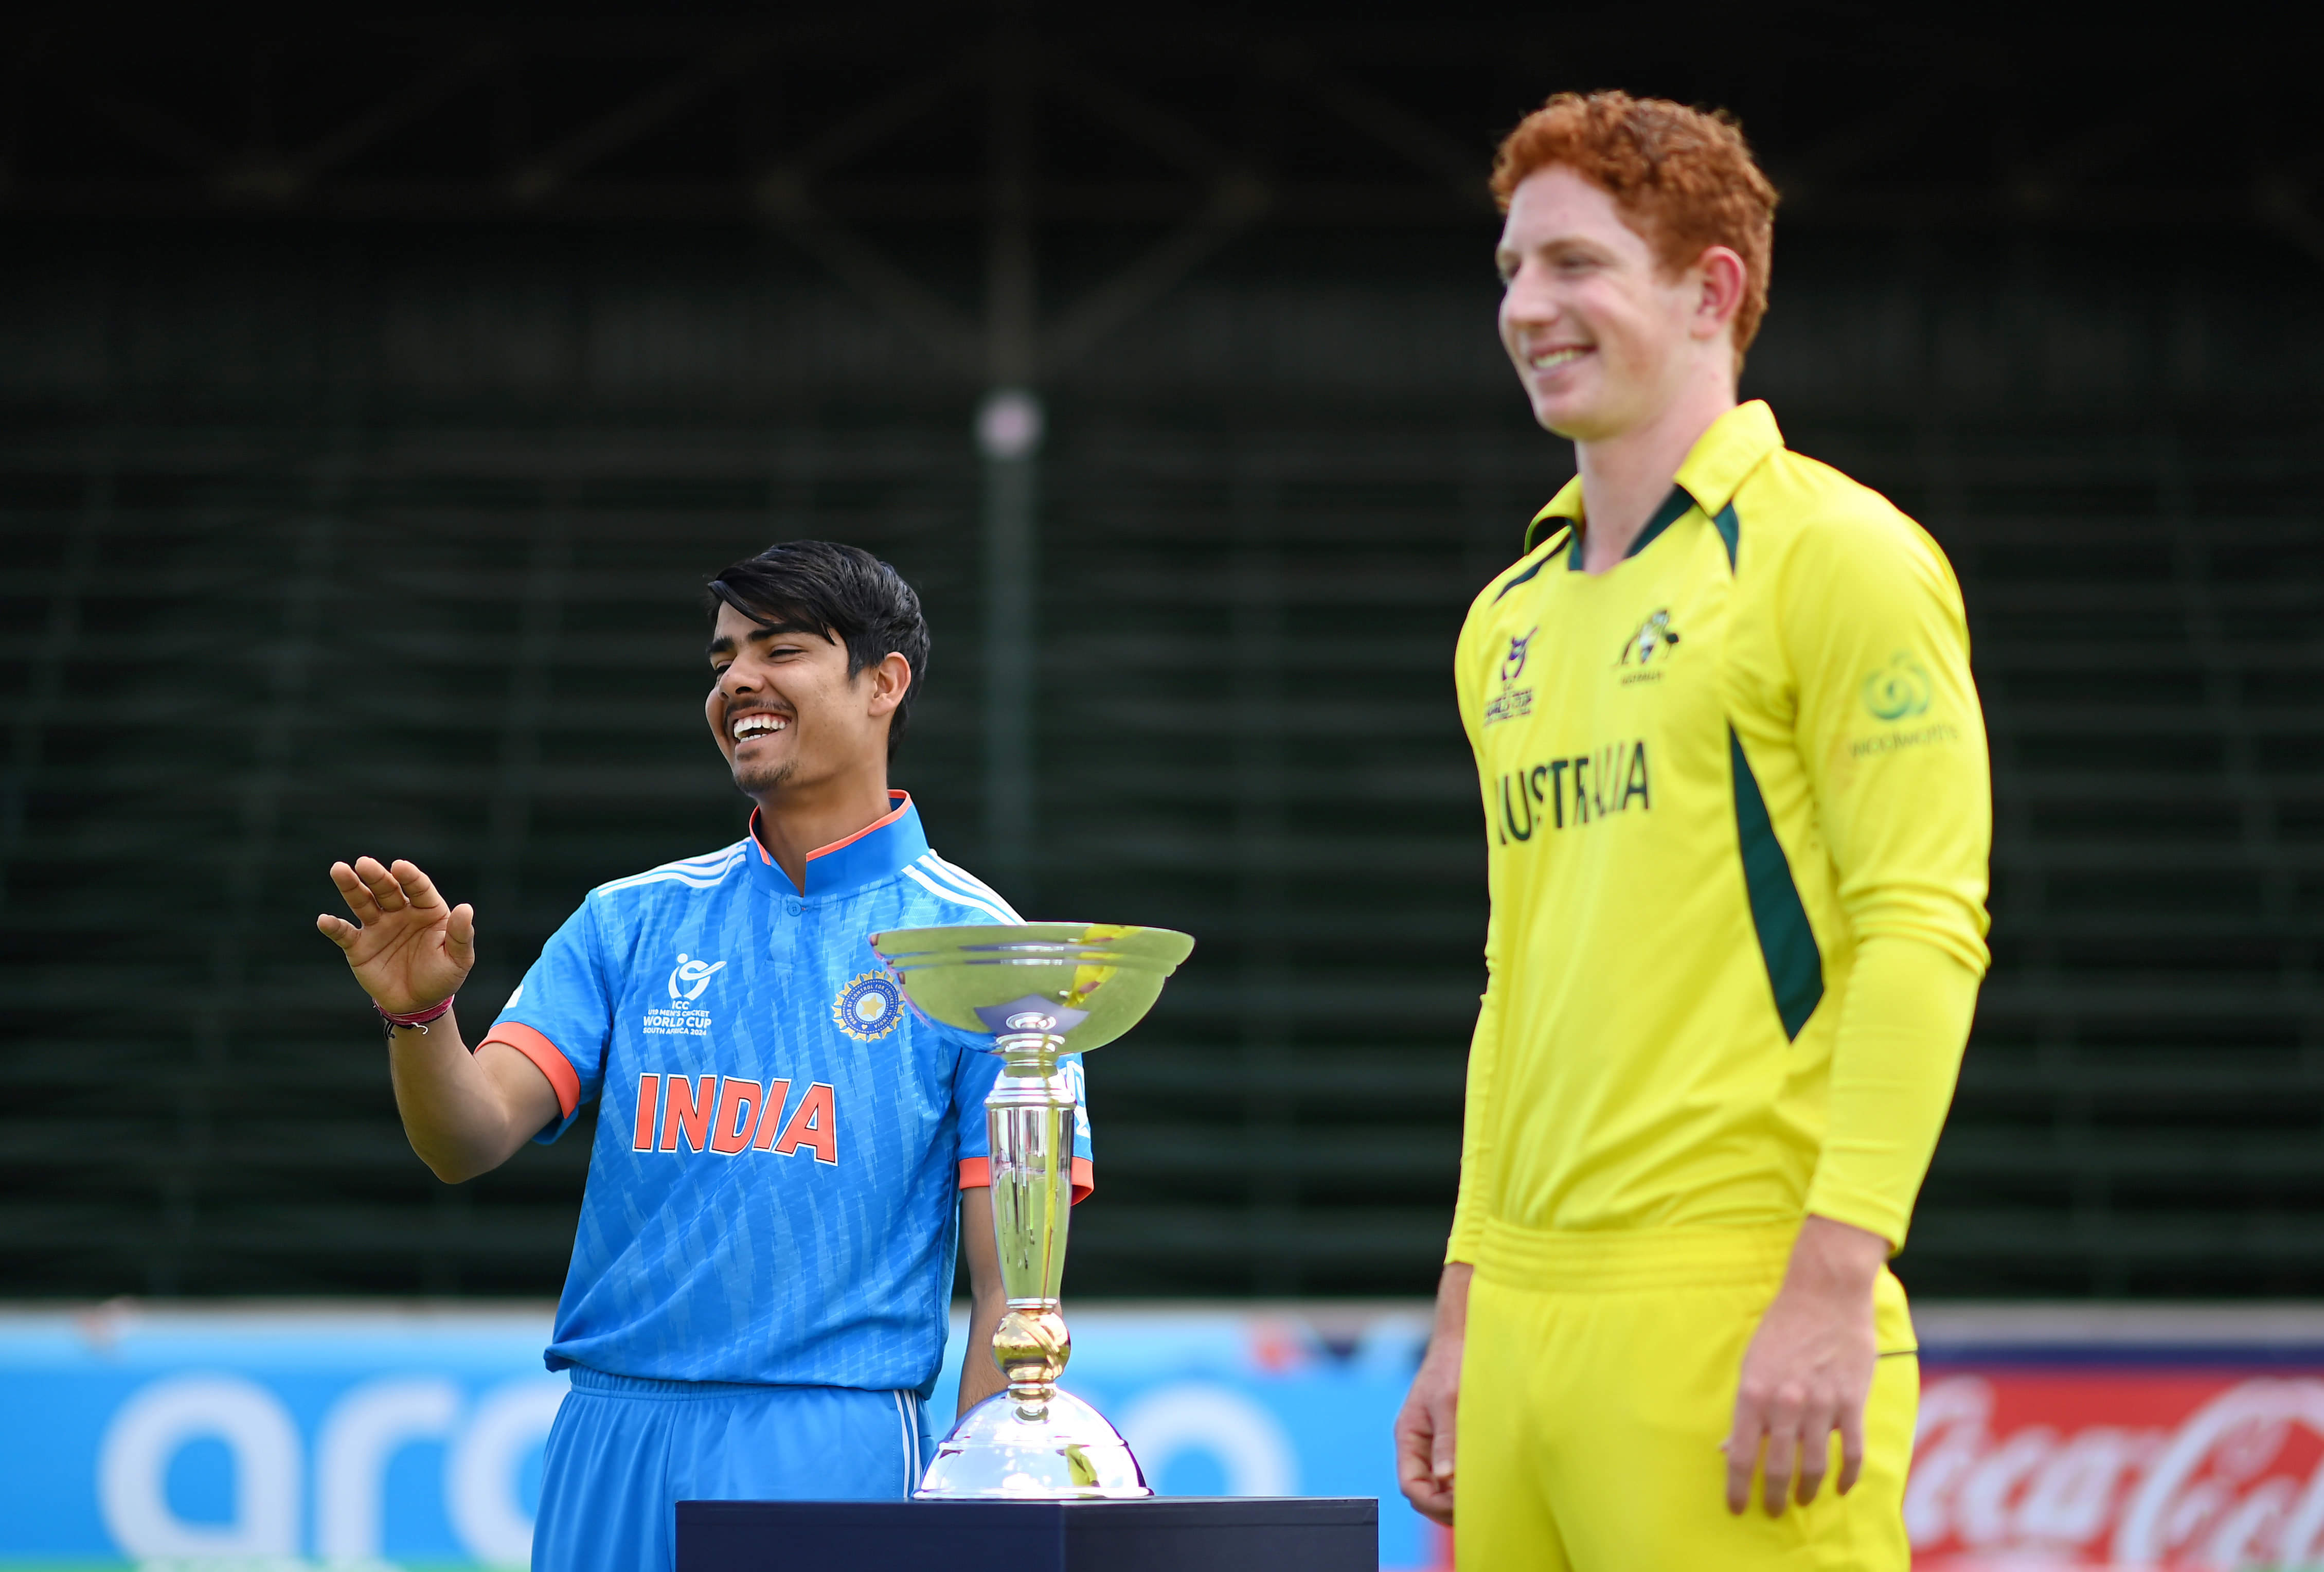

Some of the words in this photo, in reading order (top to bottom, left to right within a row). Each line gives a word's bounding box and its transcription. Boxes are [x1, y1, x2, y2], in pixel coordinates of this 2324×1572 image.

[851, 985, 873, 999] CONTROL
[672, 1000, 690, 1010] ICC
[643, 1015, 684, 1027] WORLD
[686, 1016, 712, 1028] CUP
[632, 1072, 838, 1167] INDIA
